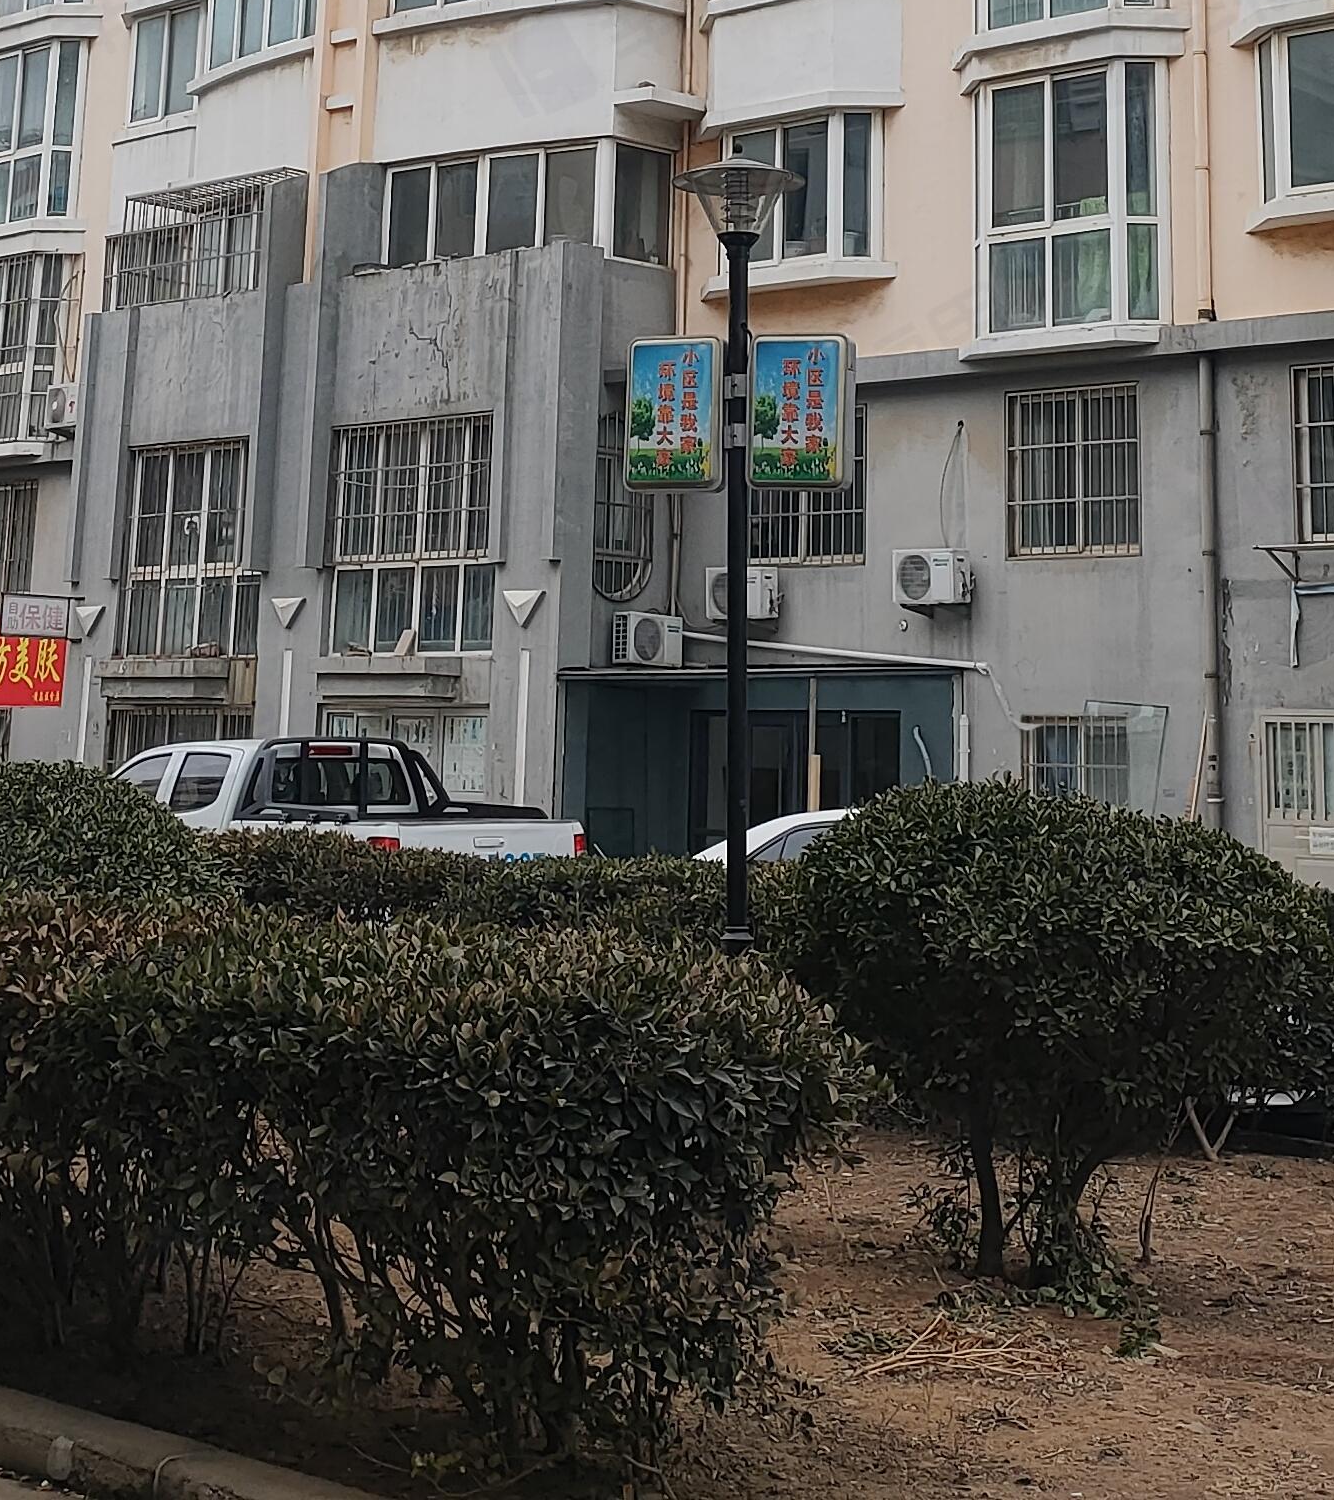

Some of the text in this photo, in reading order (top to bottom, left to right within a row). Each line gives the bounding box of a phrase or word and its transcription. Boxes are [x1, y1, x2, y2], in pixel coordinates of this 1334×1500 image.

[655, 360, 677, 467] 环境靠大家
[679, 350, 699, 455] 小区是我家
[780, 358, 801, 467] 环境靠大家
[805, 347, 826, 455] 小区是我家
[19, 603, 64, 631] 保健
